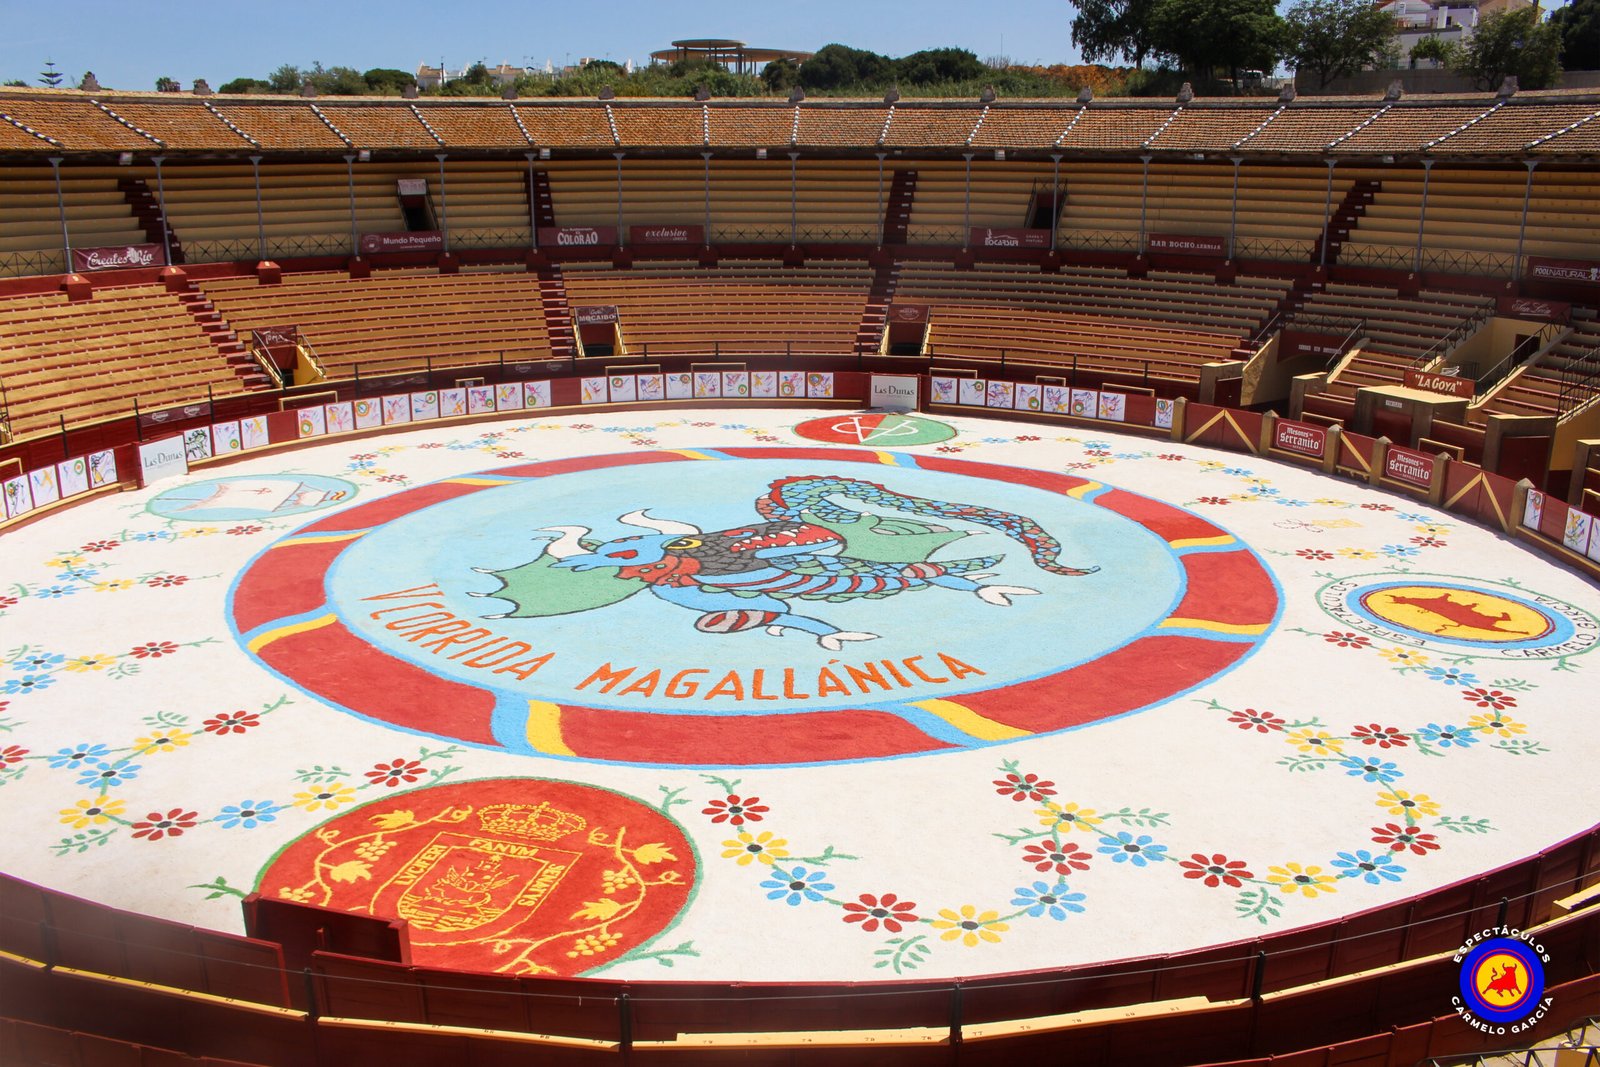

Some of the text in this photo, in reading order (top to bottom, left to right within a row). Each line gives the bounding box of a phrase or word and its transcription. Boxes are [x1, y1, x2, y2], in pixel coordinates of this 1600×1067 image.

[557, 231, 598, 245] COLORAO
[645, 227, 687, 237] exclusive
[1431, 377, 1462, 393] GOYA"
[1280, 431, 1319, 449] Serranito
[1390, 459, 1429, 480] Serranito
[370, 602, 555, 680] CORRIDA
[574, 652, 987, 701] MAGALLÁNICA
[1501, 633, 1596, 658] CARMELO
[468, 839, 539, 857] FANVM
[393, 844, 448, 886] LVCIFERI
